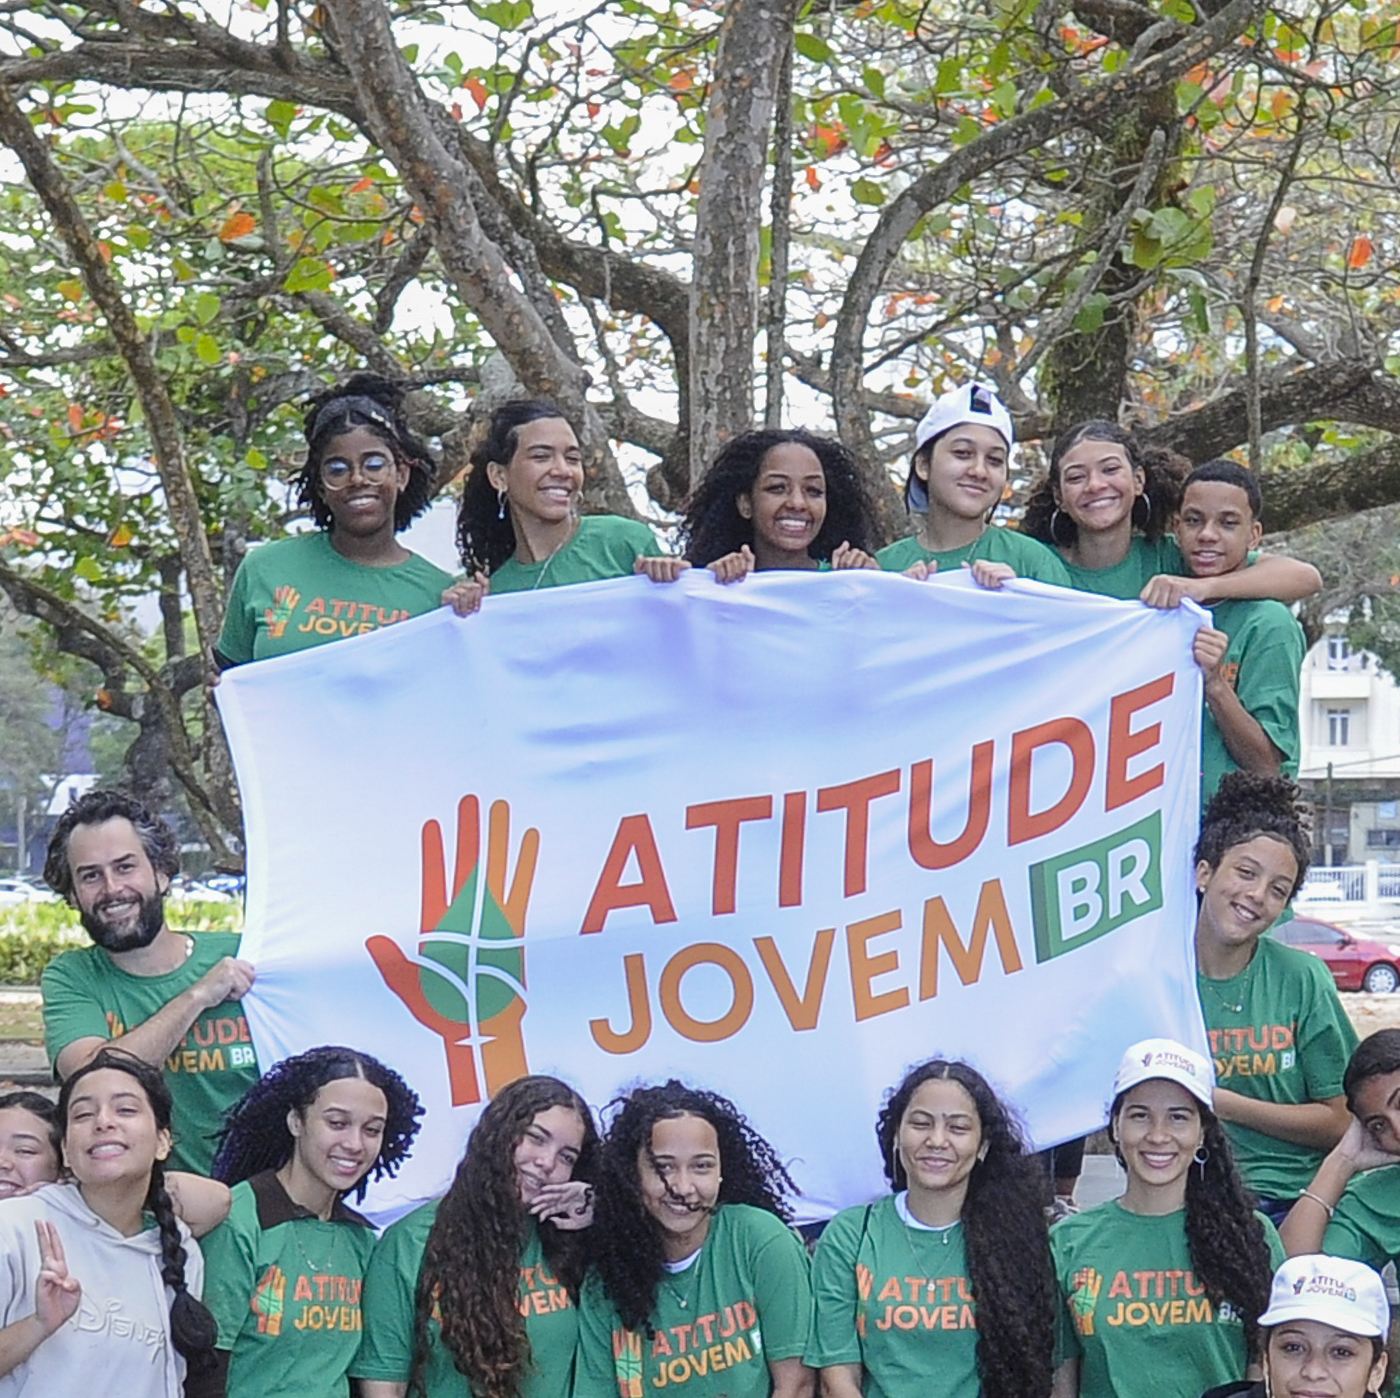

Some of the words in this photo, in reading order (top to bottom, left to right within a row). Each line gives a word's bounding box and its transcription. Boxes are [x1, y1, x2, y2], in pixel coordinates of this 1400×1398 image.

[304, 596, 411, 625] ATITU
[299, 615, 375, 637] JOVE
[580, 671, 1176, 935] ATITUDE
[588, 877, 1024, 1056] JOVEM
[1053, 834, 1155, 945] BR
[1207, 1020, 1298, 1053] TITUD
[167, 1048, 226, 1073] VEM
[293, 1274, 362, 1304] ATITU
[877, 1276, 976, 1304] ATITU
[1107, 1270, 1207, 1299] ATITU
[1107, 1298, 1213, 1327] JOVEM
[652, 1299, 757, 1358] ATITUD
[652, 1336, 752, 1388] JOVEM
